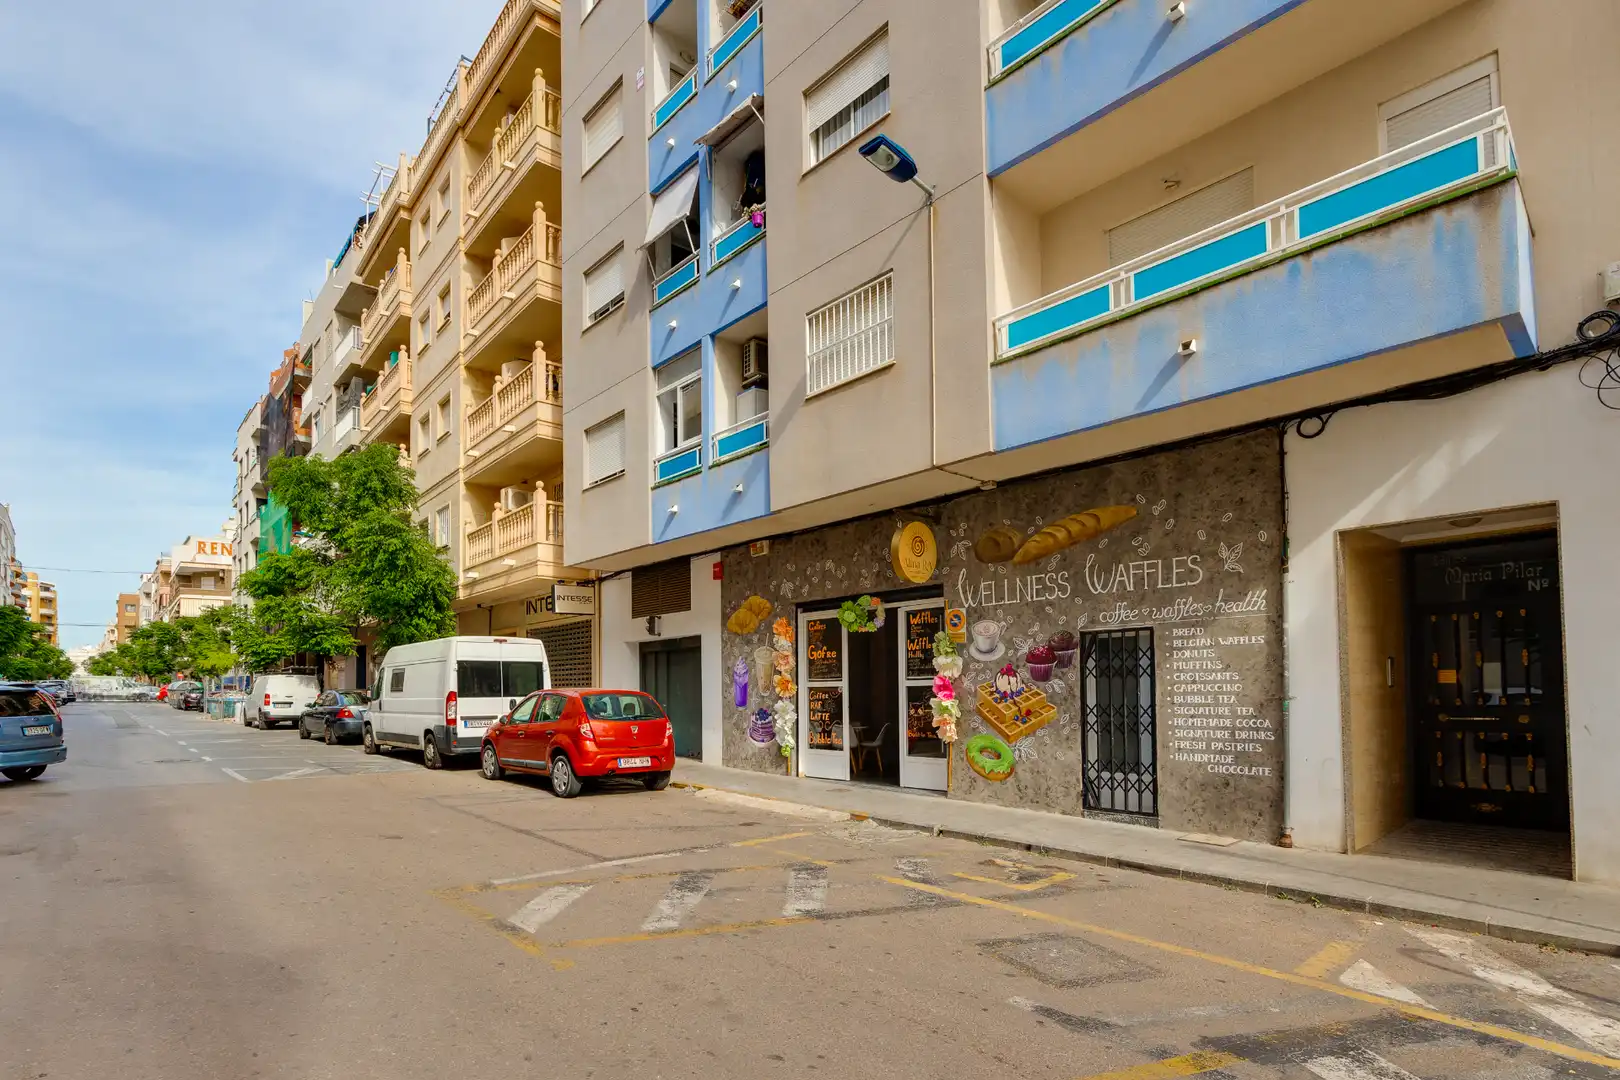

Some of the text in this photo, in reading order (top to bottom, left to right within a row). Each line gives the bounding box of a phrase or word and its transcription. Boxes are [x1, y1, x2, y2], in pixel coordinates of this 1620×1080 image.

[197, 540, 233, 556] REN
[1501, 561, 1544, 581] Pilar
[955, 553, 1203, 608] WELLNESS WAFFLES
[556, 594, 593, 603] INTESSE
[1100, 588, 1268, 625] coffee waffles health
[1172, 627, 1204, 637] BREAD
[1218, 635, 1265, 645] WAFFLES
[1173, 649, 1215, 659] DONUTS
[1172, 660, 1223, 670] MUFFINS
[1173, 672, 1240, 681] CROISSANTS
[1173, 683, 1243, 692] CAPPUCCINO
[1173, 695, 1238, 704] BUBBLE TEA
[1174, 706, 1256, 716] SIGNATURE TEA
[1173, 718, 1272, 728] HOMEMADE COCOA
[1174, 729, 1275, 741] SIGNATURE DRINKS
[1174, 740, 1263, 752] FRESH PASTRIES
[1175, 752, 1235, 764] HANDMADE
[1207, 764, 1272, 776] CHOCOLATE
